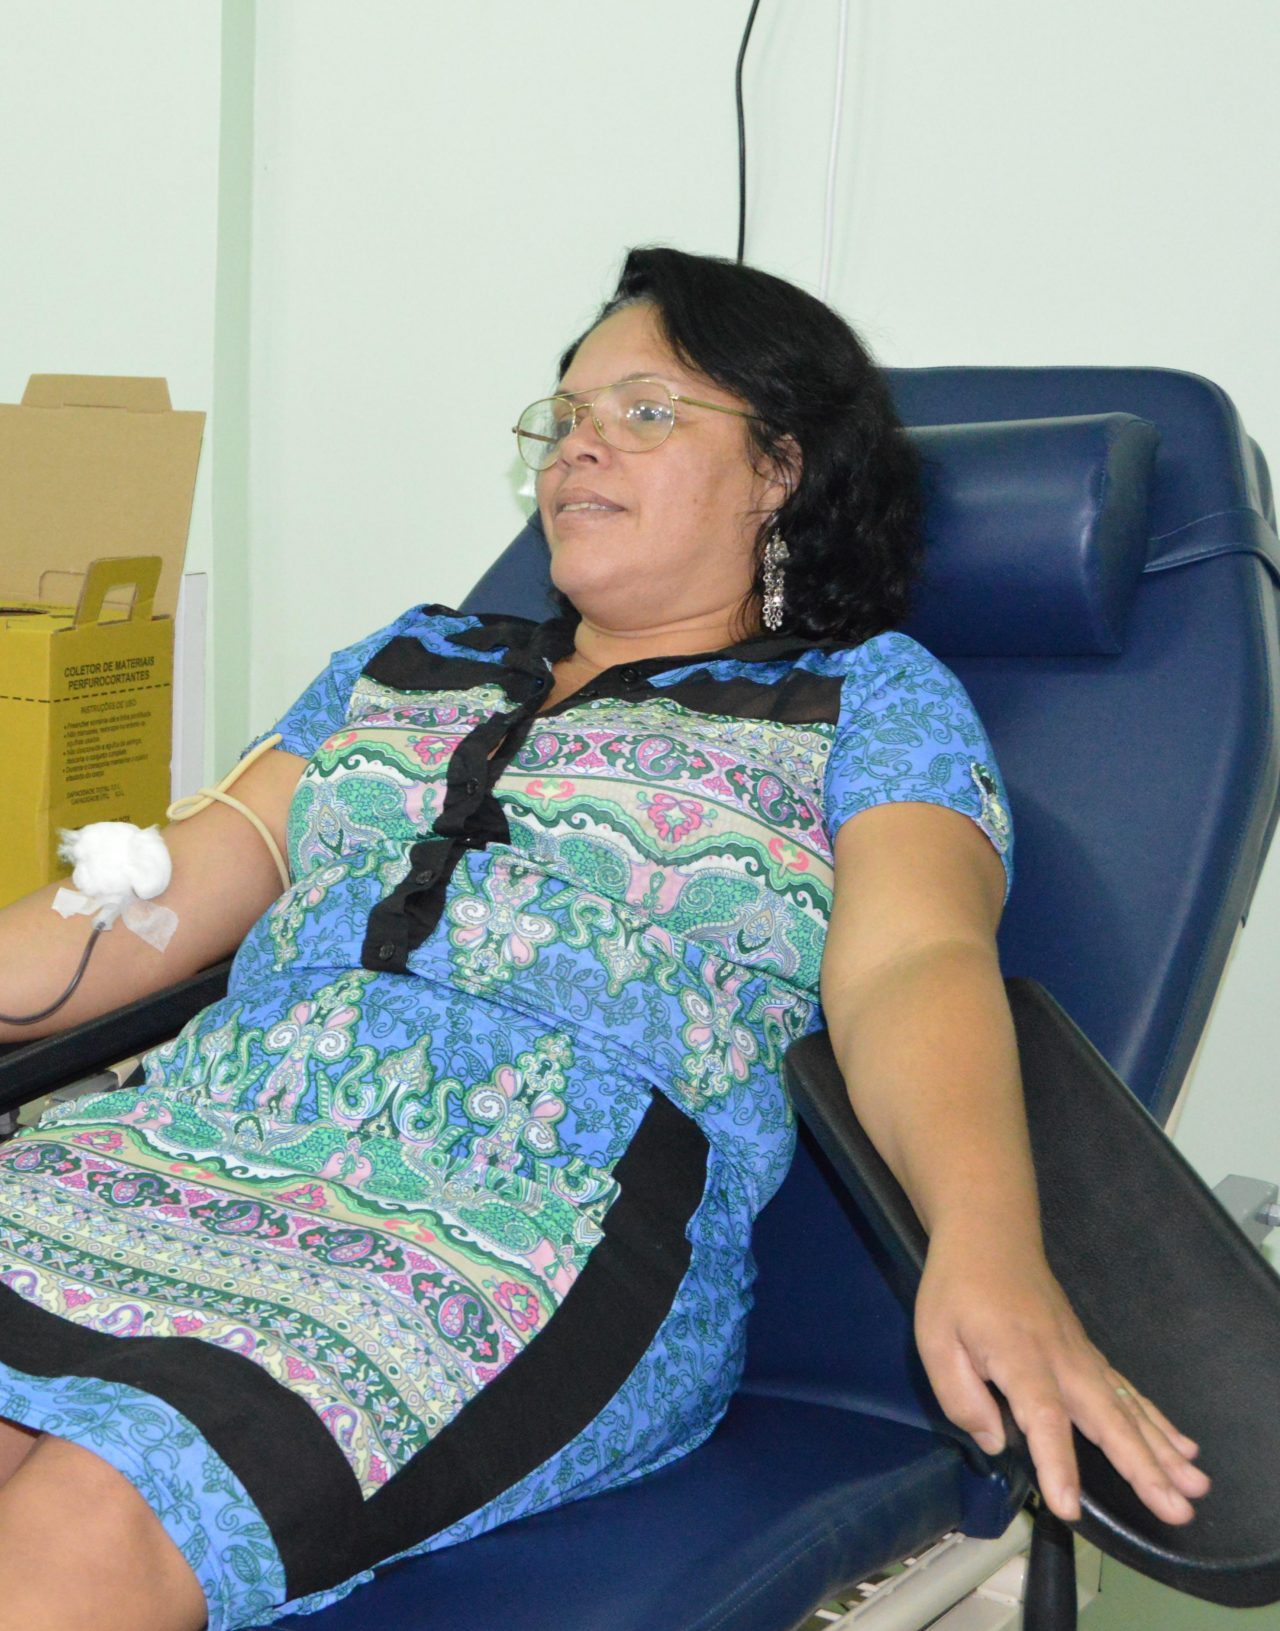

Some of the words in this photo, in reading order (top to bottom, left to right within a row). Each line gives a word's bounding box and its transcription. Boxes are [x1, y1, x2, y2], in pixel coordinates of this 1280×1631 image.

[64, 663, 101, 677] COLETOR
[102, 661, 113, 672] DE
[114, 656, 155, 670] MATERIAIS
[68, 670, 150, 690] PERFUROCORTANTES
